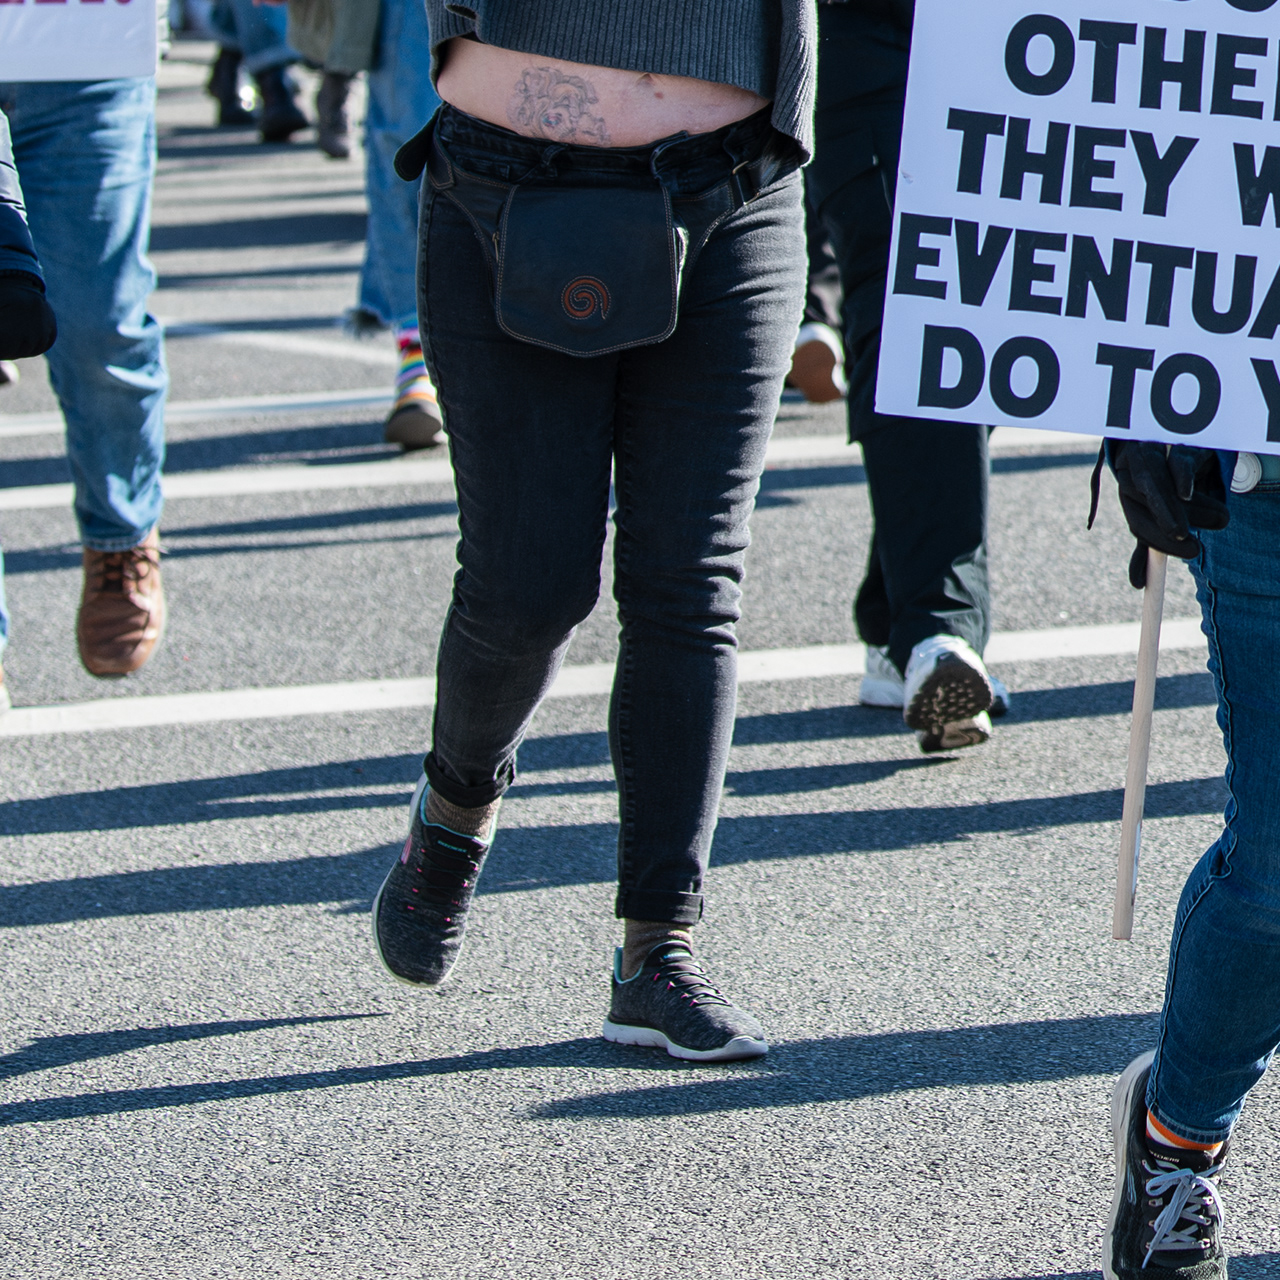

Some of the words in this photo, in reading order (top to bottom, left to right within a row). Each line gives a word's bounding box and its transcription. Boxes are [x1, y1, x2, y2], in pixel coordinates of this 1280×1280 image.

[946, 107, 1201, 218] THEY
[917, 323, 1061, 420] DO
[1095, 341, 1222, 436] TO
